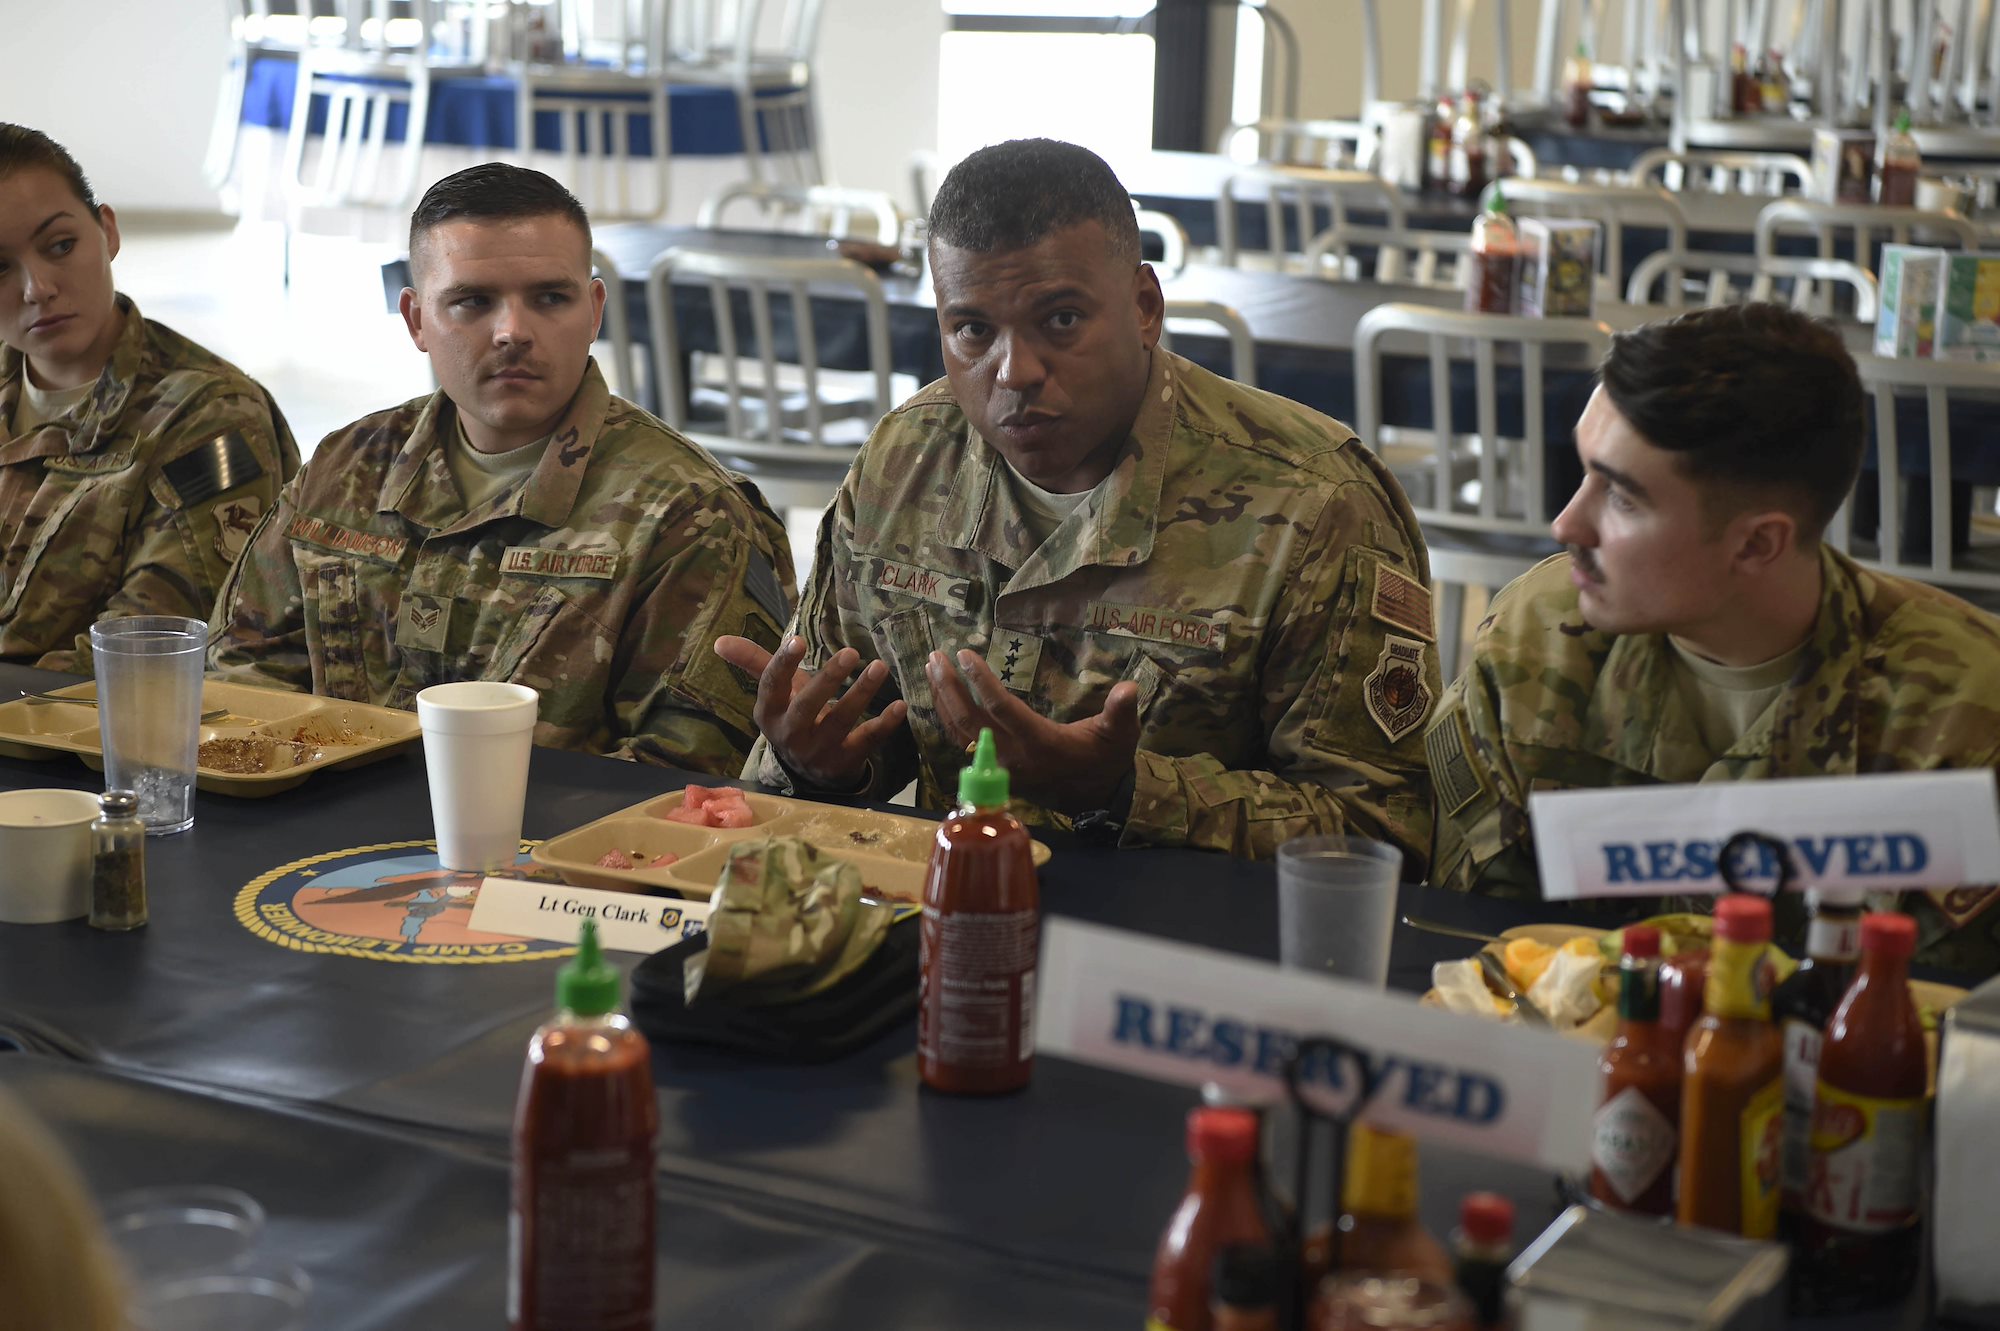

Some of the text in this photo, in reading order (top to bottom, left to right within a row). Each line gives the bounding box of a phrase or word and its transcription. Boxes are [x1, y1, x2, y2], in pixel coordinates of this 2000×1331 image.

[291, 518, 402, 557] WILLIAMSON
[538, 553, 564, 573] AIR
[567, 554, 612, 573] FORCE
[881, 564, 941, 598] CLARK
[1125, 611, 1156, 636] AIR
[1159, 616, 1220, 645] FORCE
[1390, 643, 1420, 661] GRADUATE
[538, 896, 650, 924] Lt Gen Clark
[259, 902, 528, 956] CAMP LEMONNIER
